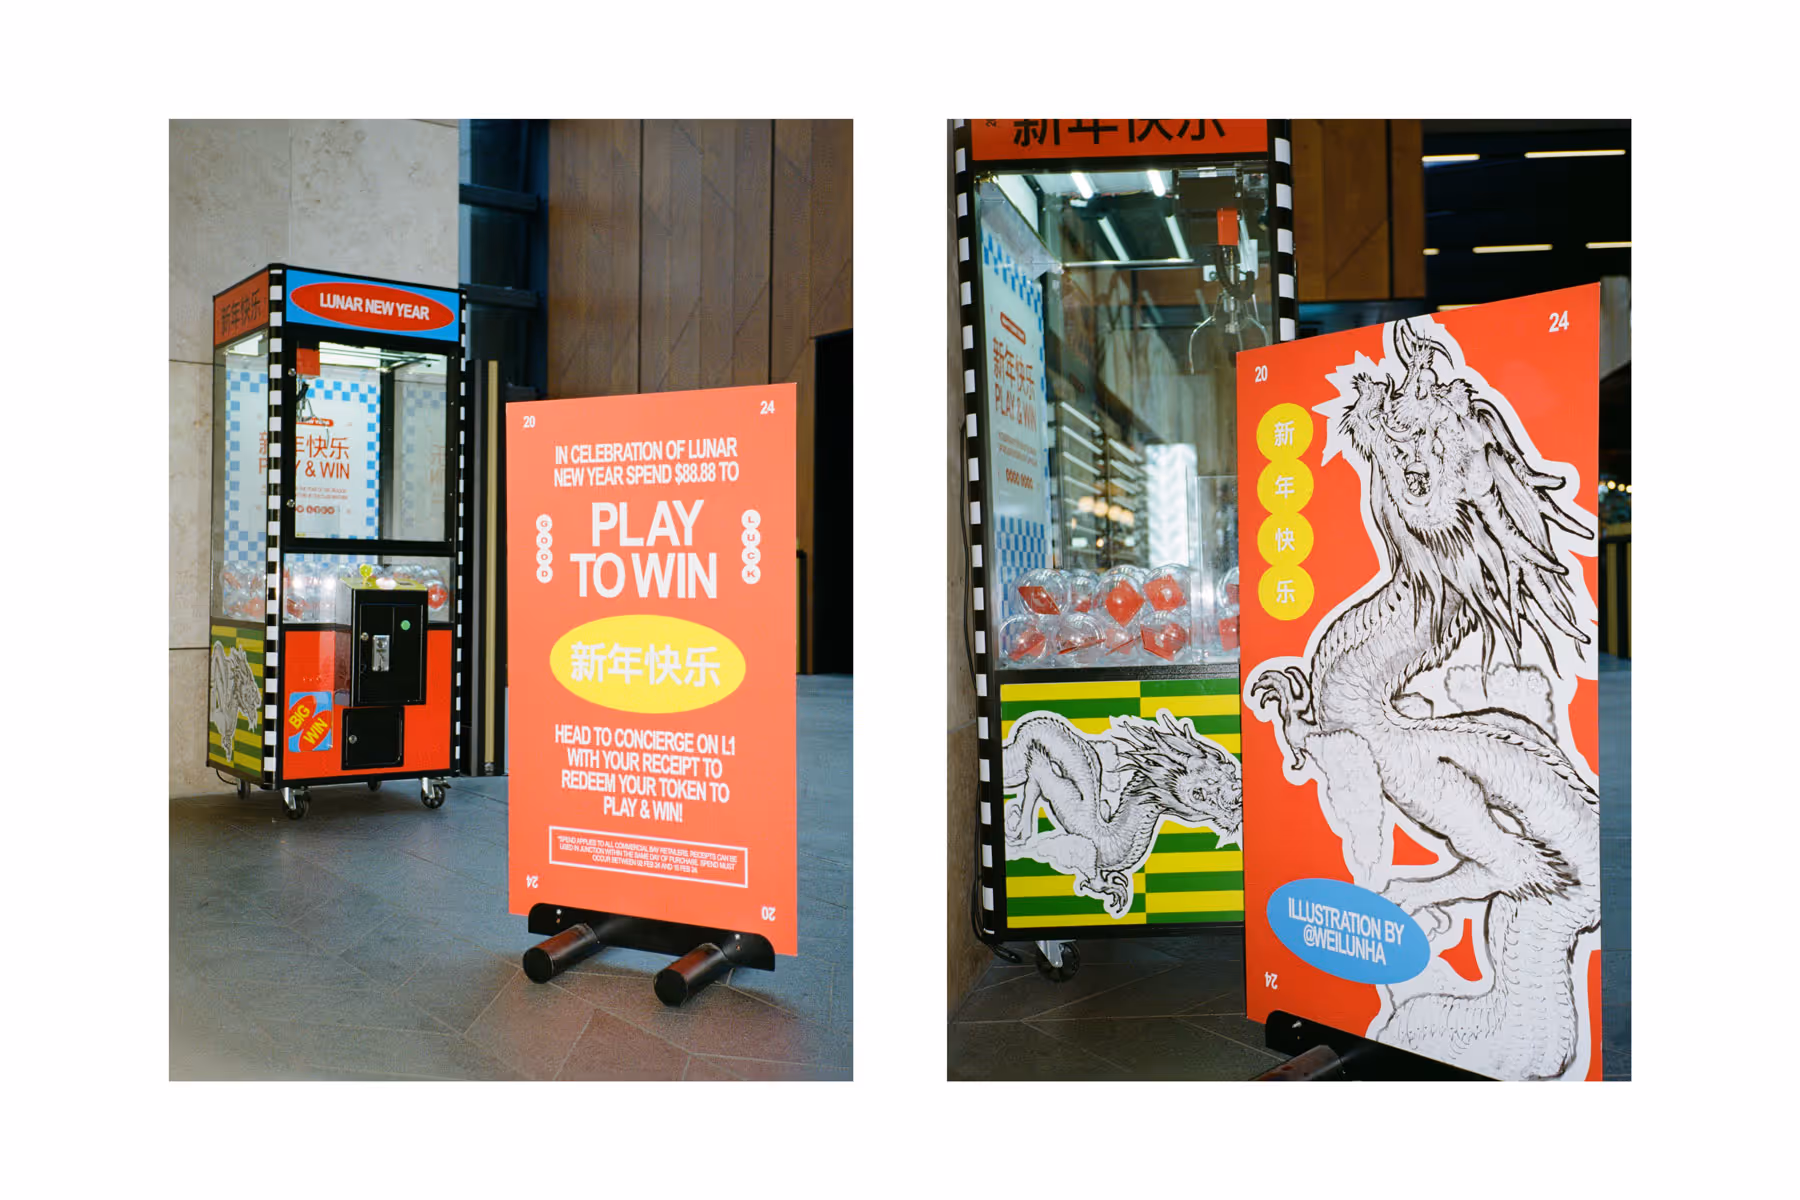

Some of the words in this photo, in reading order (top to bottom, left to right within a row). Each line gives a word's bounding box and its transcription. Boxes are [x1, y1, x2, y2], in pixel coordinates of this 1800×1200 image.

[320, 292, 363, 312] LUNAR
[365, 298, 394, 316] NEW
[396, 302, 430, 320] YEAR
[1549, 310, 1569, 333] 24
[1254, 365, 1268, 383] 20
[760, 400, 774, 414] 24
[523, 415, 535, 427] 20
[555, 445, 567, 464] IN
[570, 440, 662, 463] CELEBRATION
[665, 439, 685, 459] OF
[688, 437, 737, 458] LUNAR
[305, 460, 316, 477] &
[320, 462, 349, 479] WIN
[553, 467, 585, 488] NEW
[587, 465, 623, 487] YEAR
[626, 463, 672, 486] SPEND
[675, 461, 715, 484] $88.88
[718, 460, 739, 483] TO
[592, 499, 704, 547] PLAY
[538, 518, 550, 580] GOOD
[745, 514, 757, 580] LUCK
[569, 552, 625, 598] TO
[631, 552, 717, 599] WIN
[570, 640, 720, 688] 新年快乐
[288, 705, 310, 729] BIG
[303, 717, 328, 744] WIN
[555, 724, 591, 745] HEAD
[593, 726, 612, 747] TO
[614, 728, 693, 753] CONCIERGE
[696, 733, 718, 755] ON
[721, 734, 735, 756] L1
[567, 747, 599, 769] WITH
[601, 750, 639, 772] YOUR
[642, 753, 699, 777] RECEIPT
[702, 757, 722, 779] TO
[561, 769, 615, 793] REDEEM
[618, 774, 655, 796] YOUR
[658, 777, 706, 801] TOKEN
[709, 781, 729, 803] TO
[603, 795, 637, 818] PLAY
[640, 799, 649, 819] &
[652, 800, 682, 822] WIN!
[526, 874, 539, 889] 24
[761, 906, 776, 922] 20
[1288, 897, 1382, 940] ILLUSTRATION
[1384, 921, 1404, 945] BY
[1303, 925, 1387, 965] @WEILUNHA
[1264, 971, 1278, 990] 24
